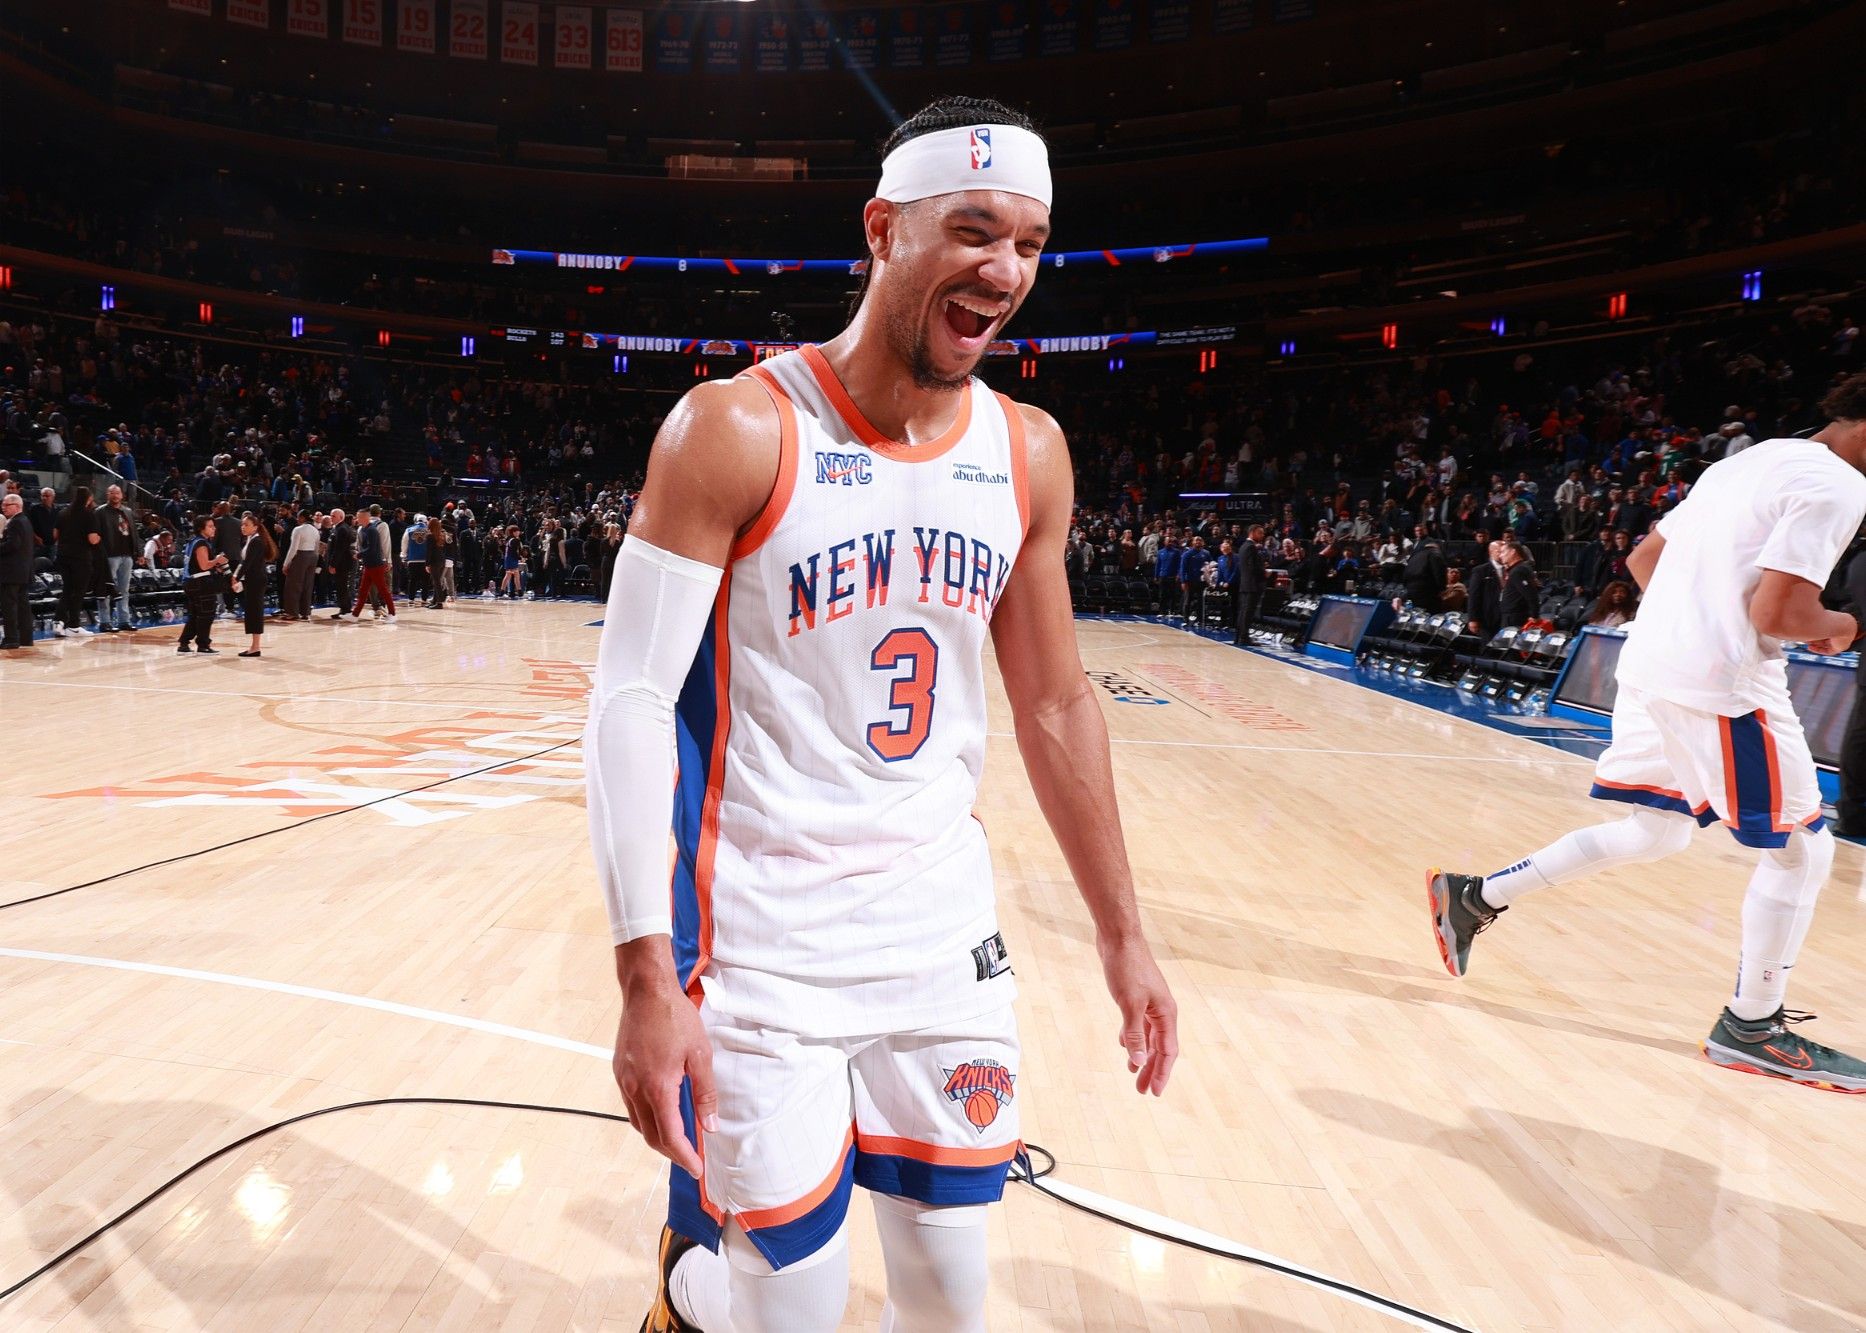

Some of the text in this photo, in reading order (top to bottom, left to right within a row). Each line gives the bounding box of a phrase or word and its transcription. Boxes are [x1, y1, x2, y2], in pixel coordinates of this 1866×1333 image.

[351, 0, 377, 25] 15
[403, 7, 429, 32] 19
[453, 13, 484, 39] 22
[505, 19, 535, 45] 24
[558, 25, 589, 48] 33
[607, 28, 641, 51] 613
[503, 48, 536, 61] KNICKS
[608, 55, 641, 67] KNICKS
[557, 253, 623, 270] ANUNOBY
[678, 259, 687, 272] 8
[1055, 254, 1064, 268] 8
[617, 336, 682, 353] ANUNOBY
[1039, 335, 1110, 353] ANUNOBY
[816, 451, 872, 486] NYC
[953, 463, 982, 471] experience
[953, 470, 1008, 484] abu dhabi
[1225, 500, 1262, 510] ULTRA
[788, 529, 895, 637] NEW
[867, 627, 939, 763] 3
[971, 1058, 1000, 1066] NEW YORK
[943, 1063, 1014, 1098] KNICKS
